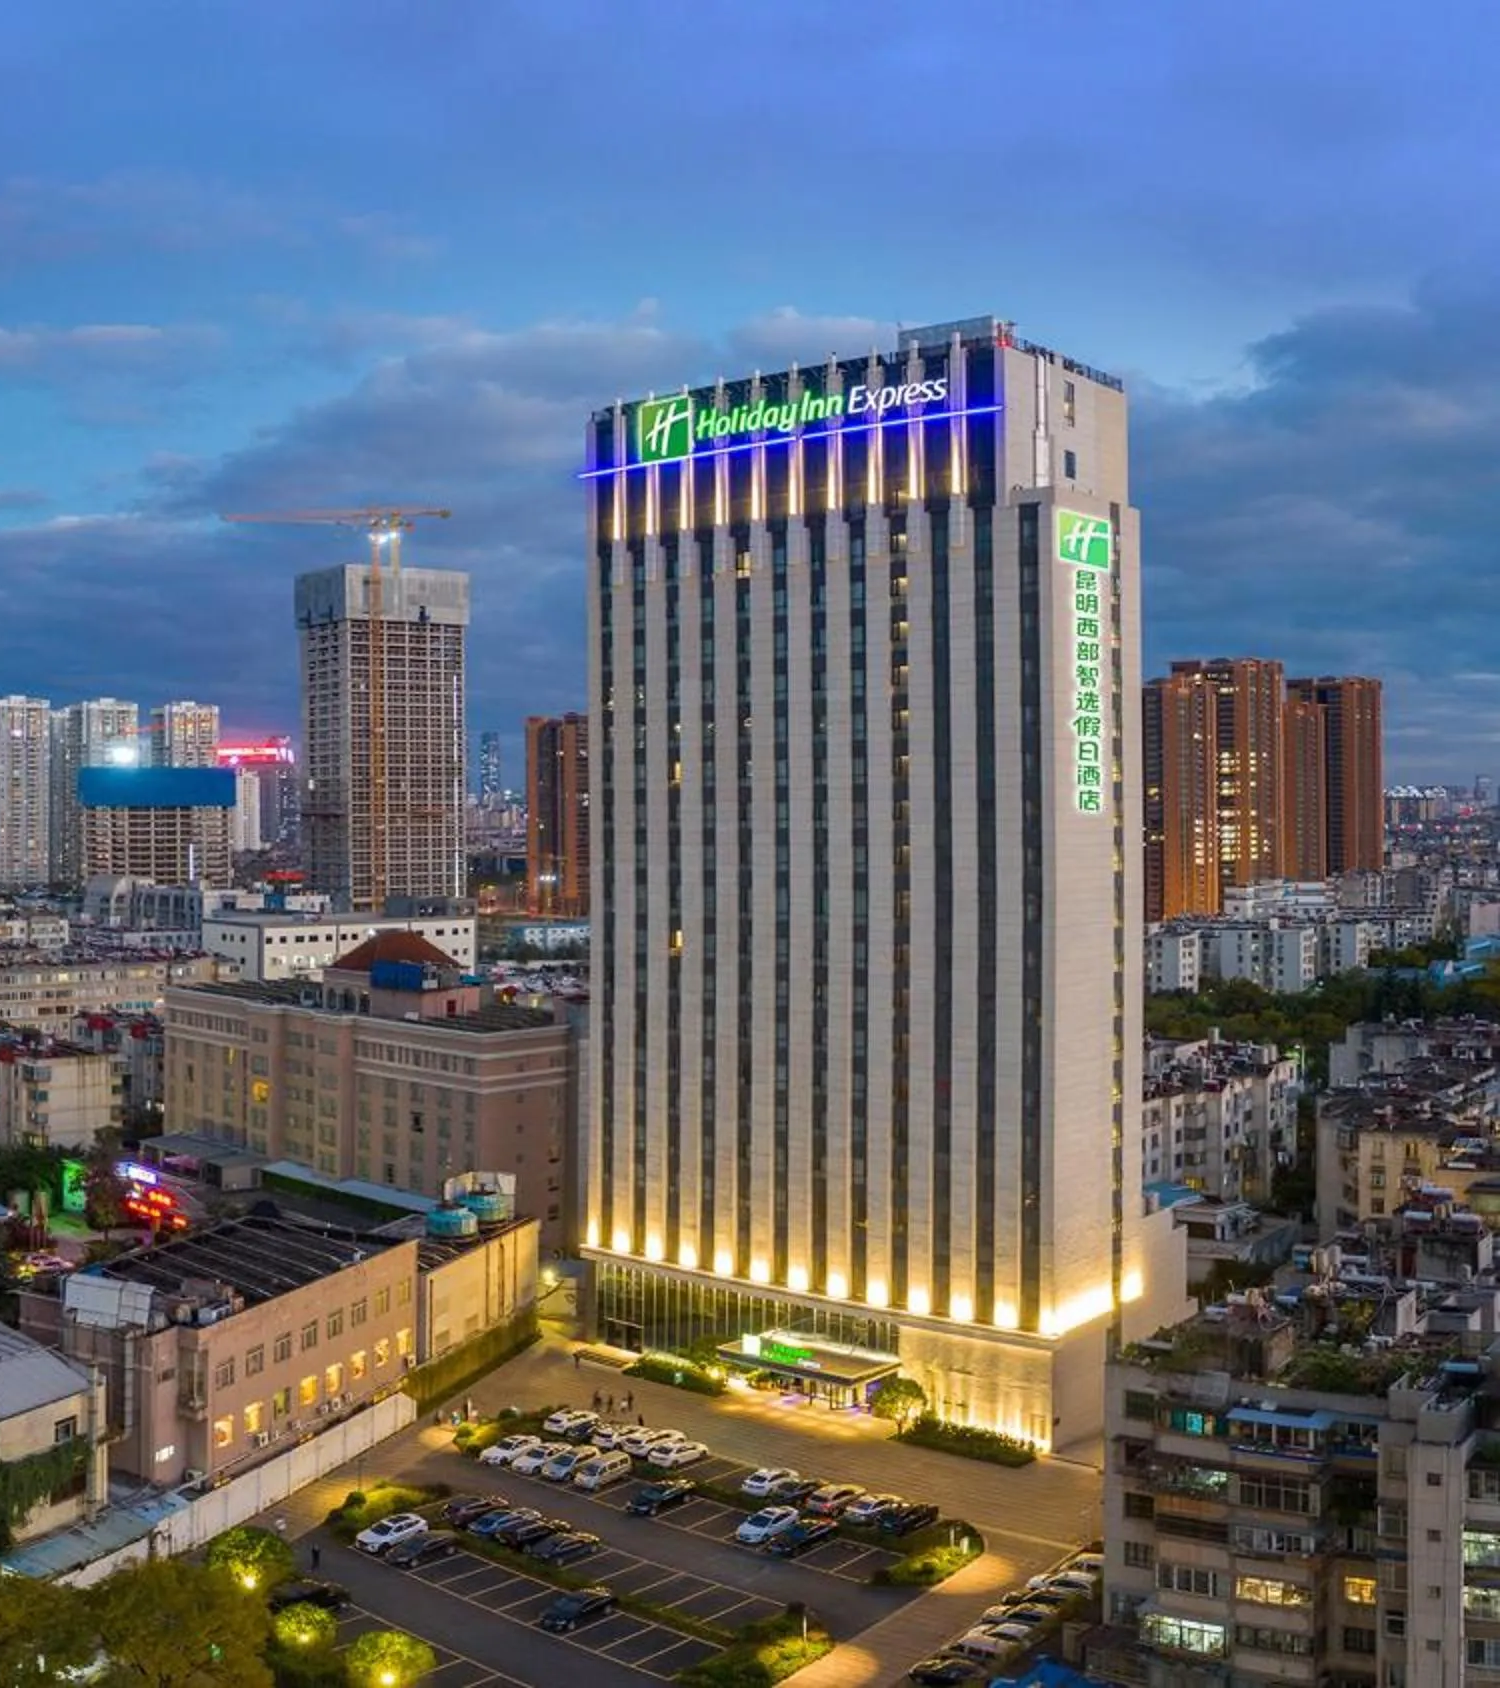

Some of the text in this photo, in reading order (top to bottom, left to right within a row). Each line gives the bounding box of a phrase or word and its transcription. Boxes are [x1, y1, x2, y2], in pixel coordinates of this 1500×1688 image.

[696, 378, 948, 439] Holiday Inn Express
[1073, 569, 1101, 811] 昆明西部智选假日酒店
